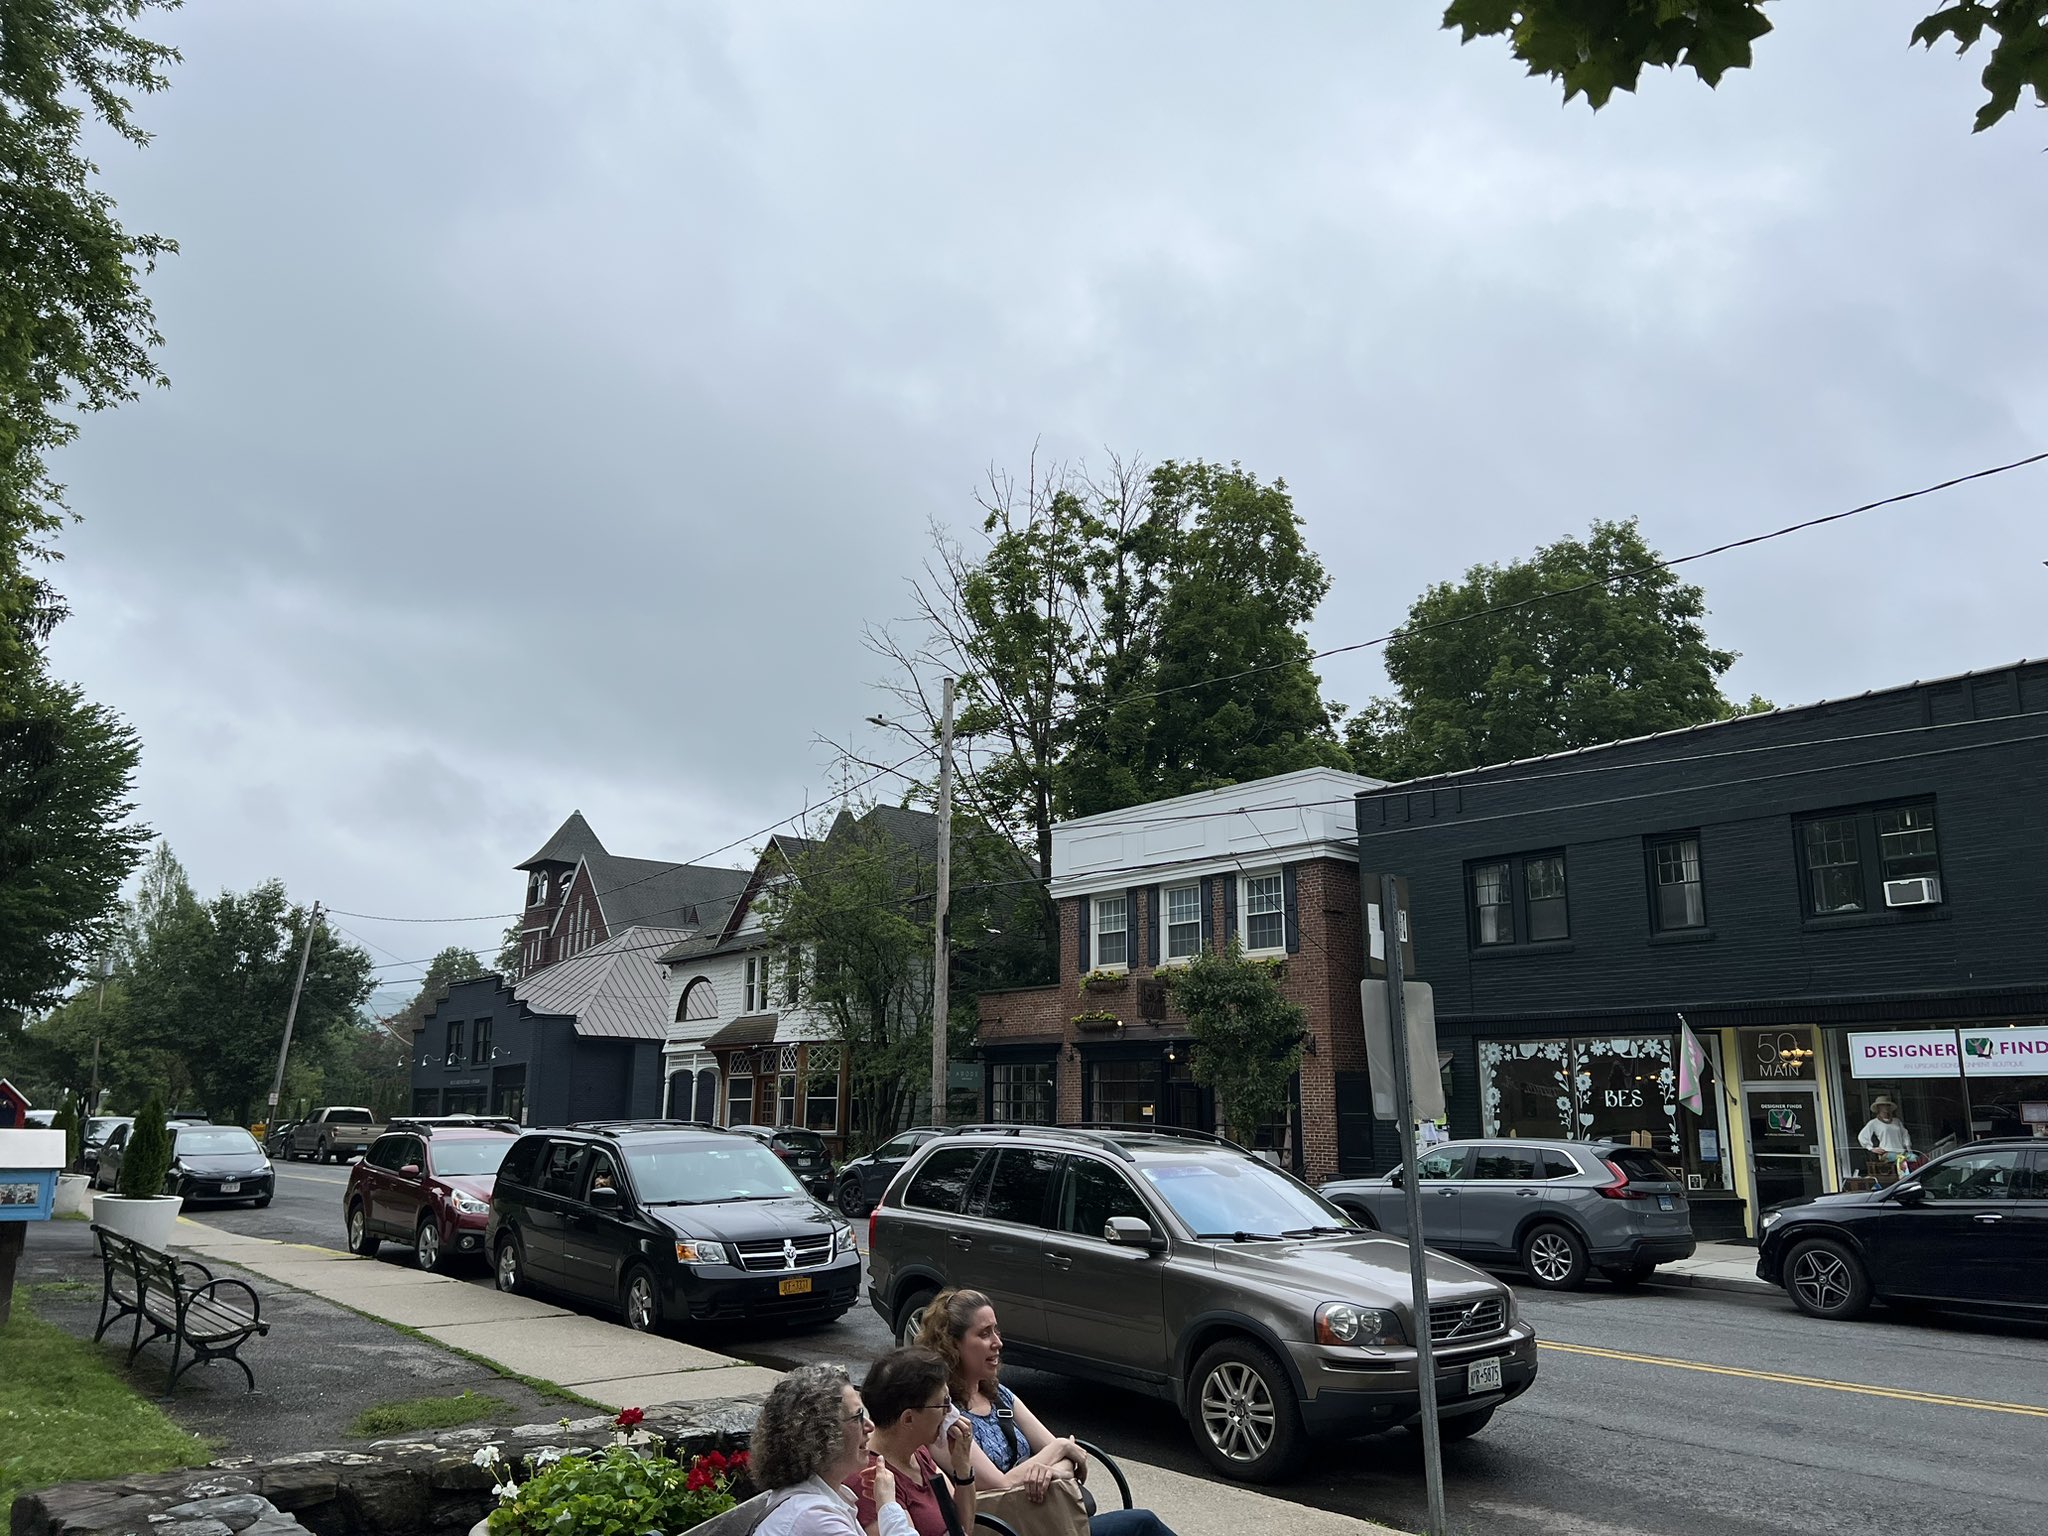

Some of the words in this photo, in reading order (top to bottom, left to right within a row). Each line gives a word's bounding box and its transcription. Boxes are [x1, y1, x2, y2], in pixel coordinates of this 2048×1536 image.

[1757, 1032, 1798, 1064] 50
[1864, 1043, 1958, 1058] DESIGNER
[1760, 1064, 1800, 1077] MAIN
[1604, 1089, 1644, 1108] BES
